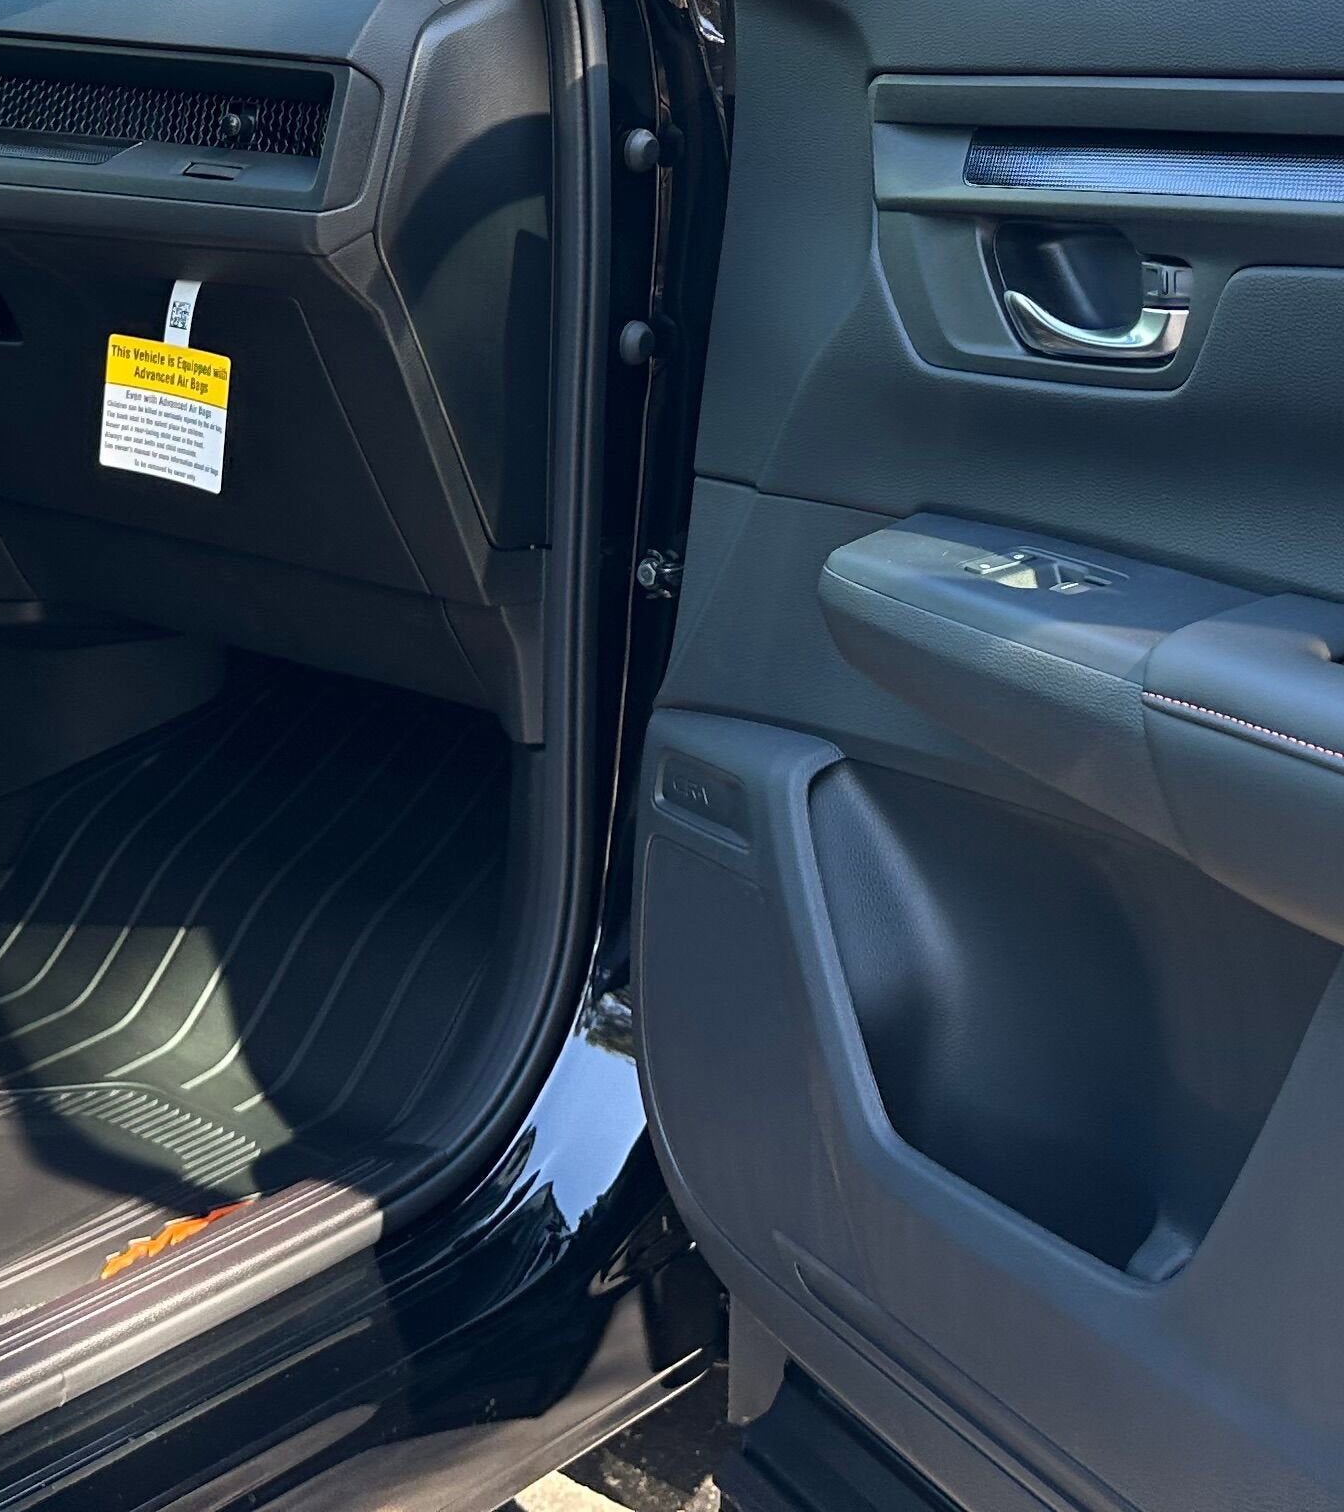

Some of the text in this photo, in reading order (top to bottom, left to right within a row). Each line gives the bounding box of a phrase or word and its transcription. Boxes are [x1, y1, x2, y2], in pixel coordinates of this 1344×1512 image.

[111, 344, 130, 359] This
[132, 347, 165, 365] Vehicle
[167, 354, 175, 367] is
[176, 356, 211, 378] Equipped
[134, 365, 174, 385] Advanced
[176, 374, 188, 387] Air
